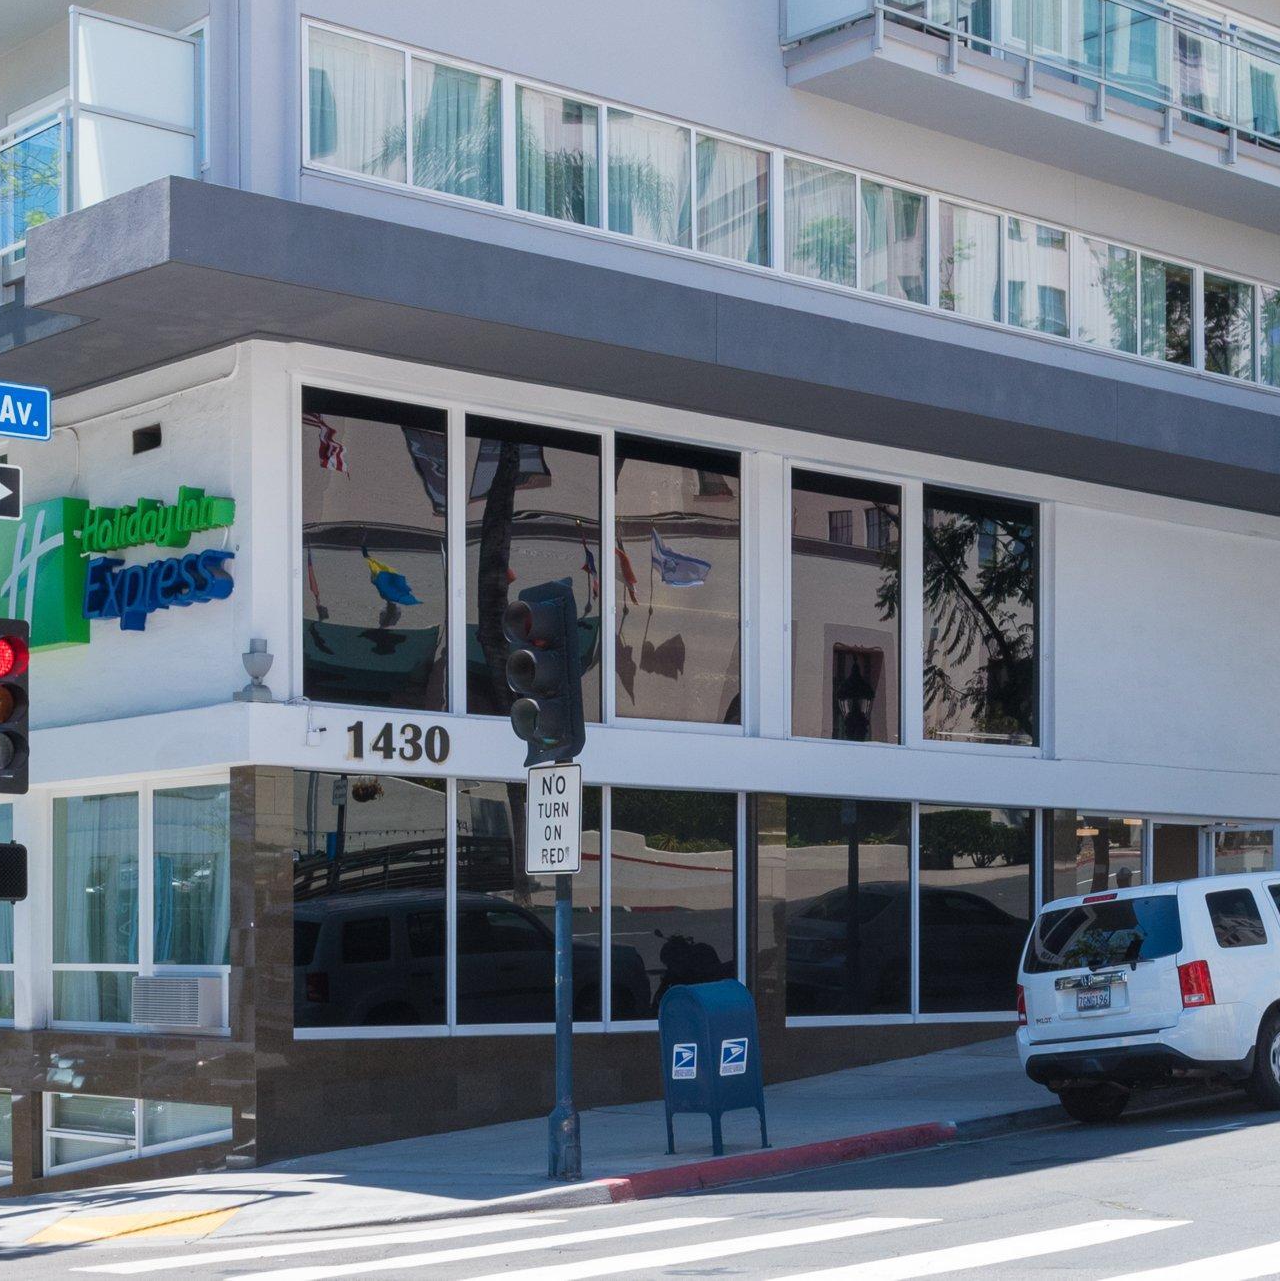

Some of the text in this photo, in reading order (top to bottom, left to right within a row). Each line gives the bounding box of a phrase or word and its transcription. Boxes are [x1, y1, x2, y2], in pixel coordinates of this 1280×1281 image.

[0, 394, 39, 427] AV.
[81, 485, 235, 553] Holiday Inn
[83, 549, 235, 632] Express
[347, 720, 450, 764] 1430
[542, 775, 566, 795] NO
[538, 802, 569, 819] TURN
[544, 825, 562, 841] ON
[541, 847, 565, 864] RED
